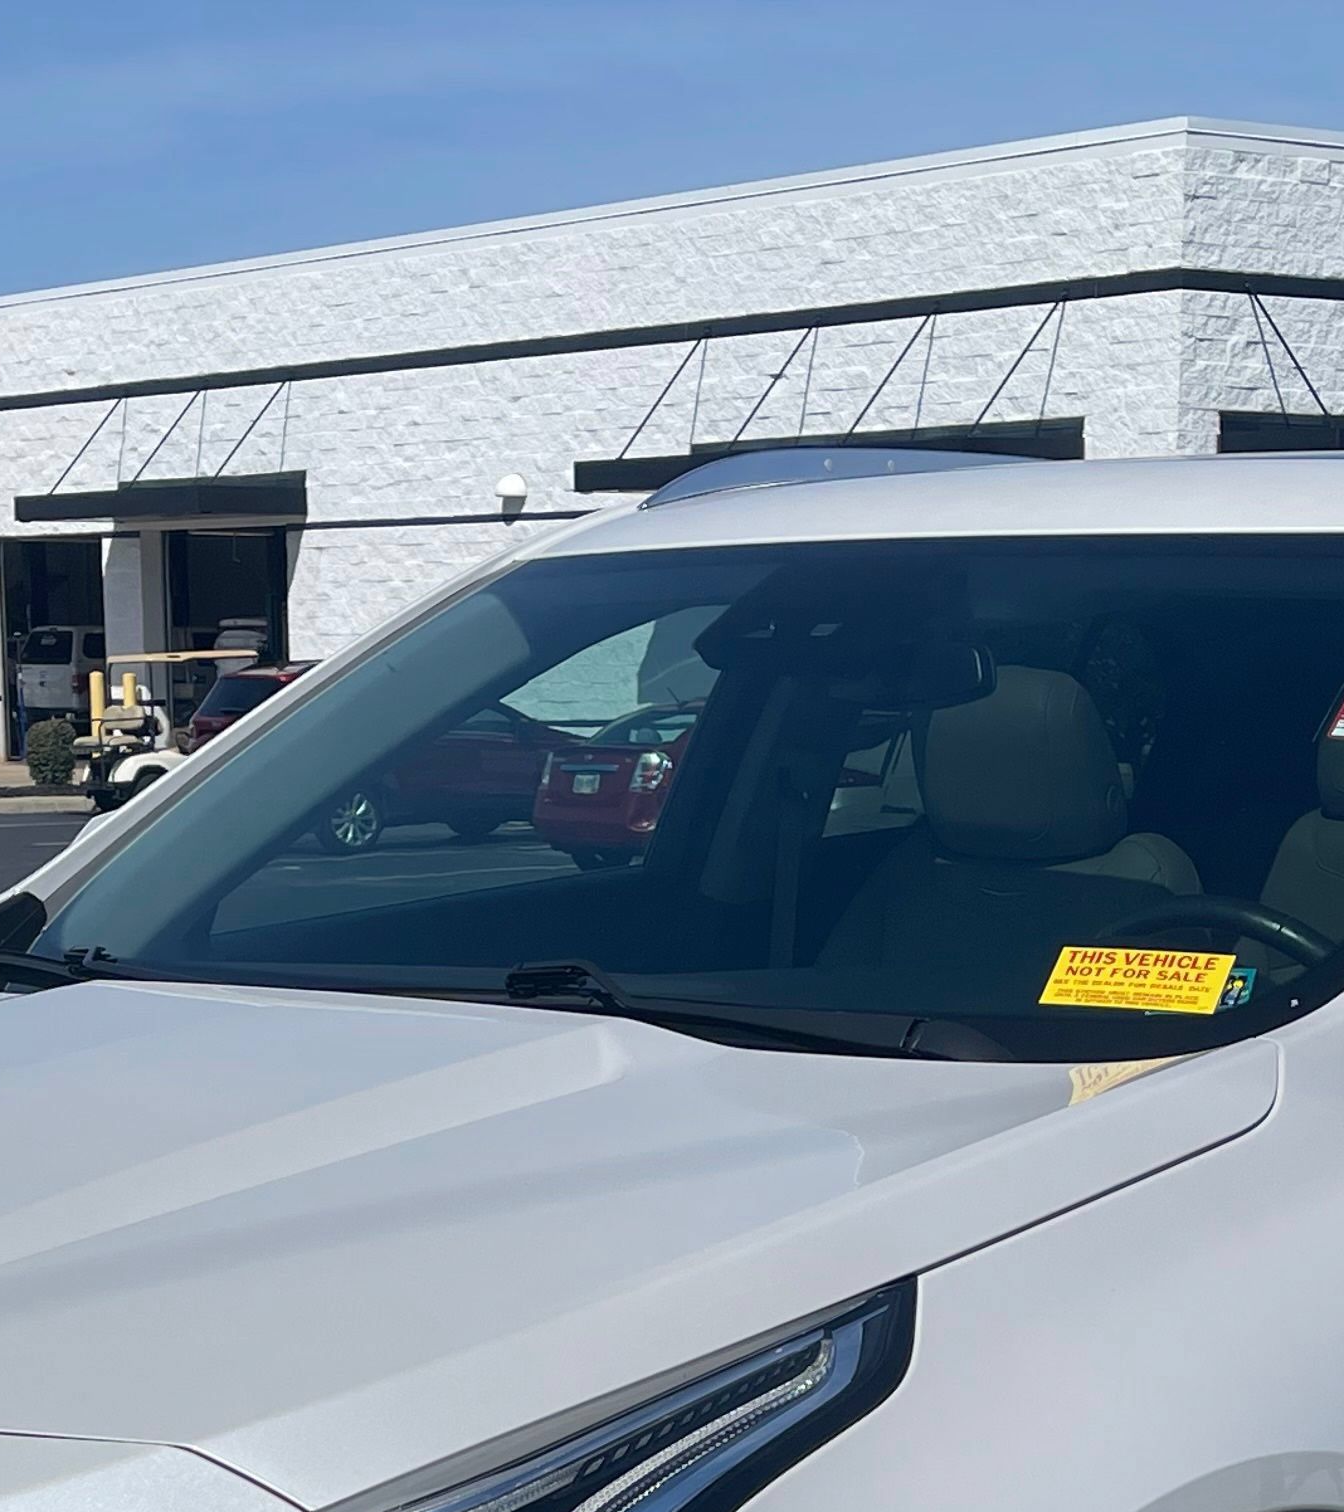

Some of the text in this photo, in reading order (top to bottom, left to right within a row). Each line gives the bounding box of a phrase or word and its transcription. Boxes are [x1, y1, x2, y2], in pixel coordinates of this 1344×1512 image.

[1068, 950, 1219, 971] THIS VEHICLE
[1065, 966, 1208, 983] NOT FOR SALE
